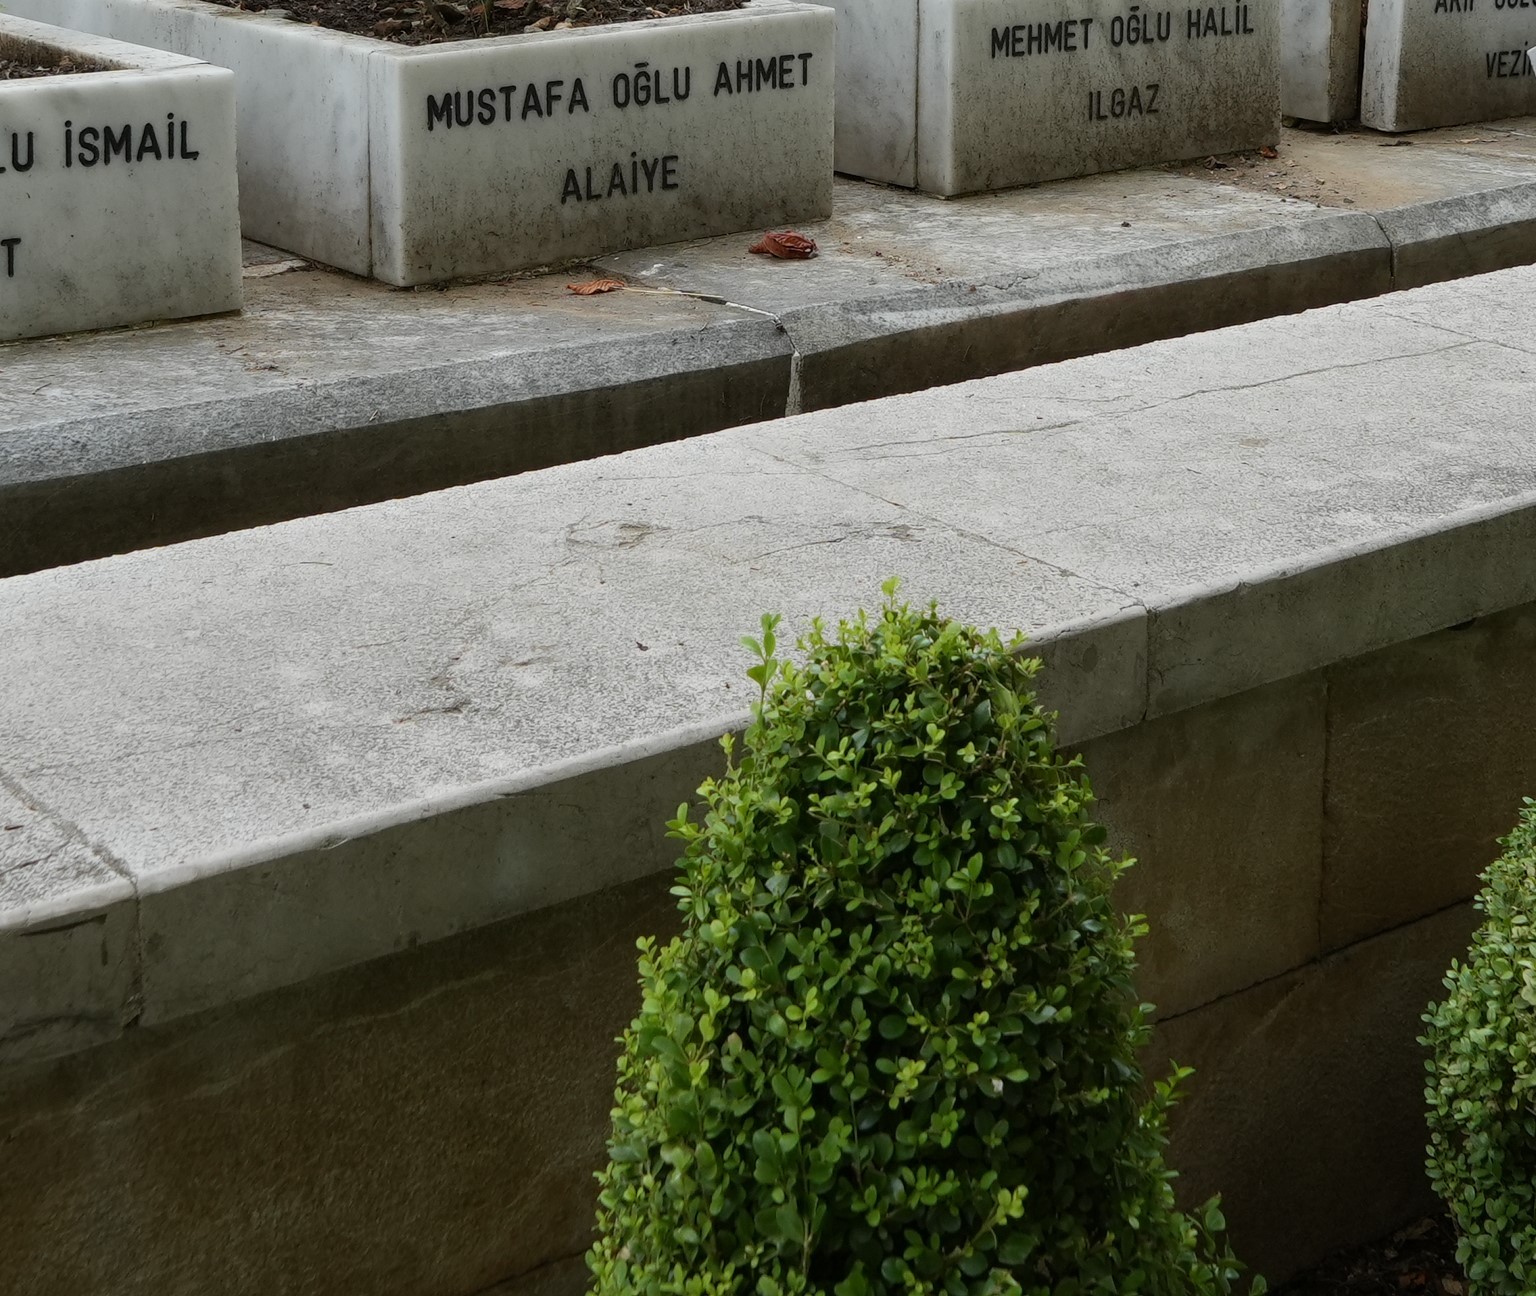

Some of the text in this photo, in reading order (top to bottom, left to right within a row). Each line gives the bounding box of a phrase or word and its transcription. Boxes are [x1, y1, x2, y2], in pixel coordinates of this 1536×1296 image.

[991, 18, 1093, 59] MEHMET
[1111, 6, 1171, 47] OĞLU
[427, 52, 813, 131] MUSTAFA OĞLU AHMET
[1088, 84, 1160, 122] ILGAZ
[64, 112, 199, 169] İSMAİL
[560, 151, 679, 204] ALAİYE
